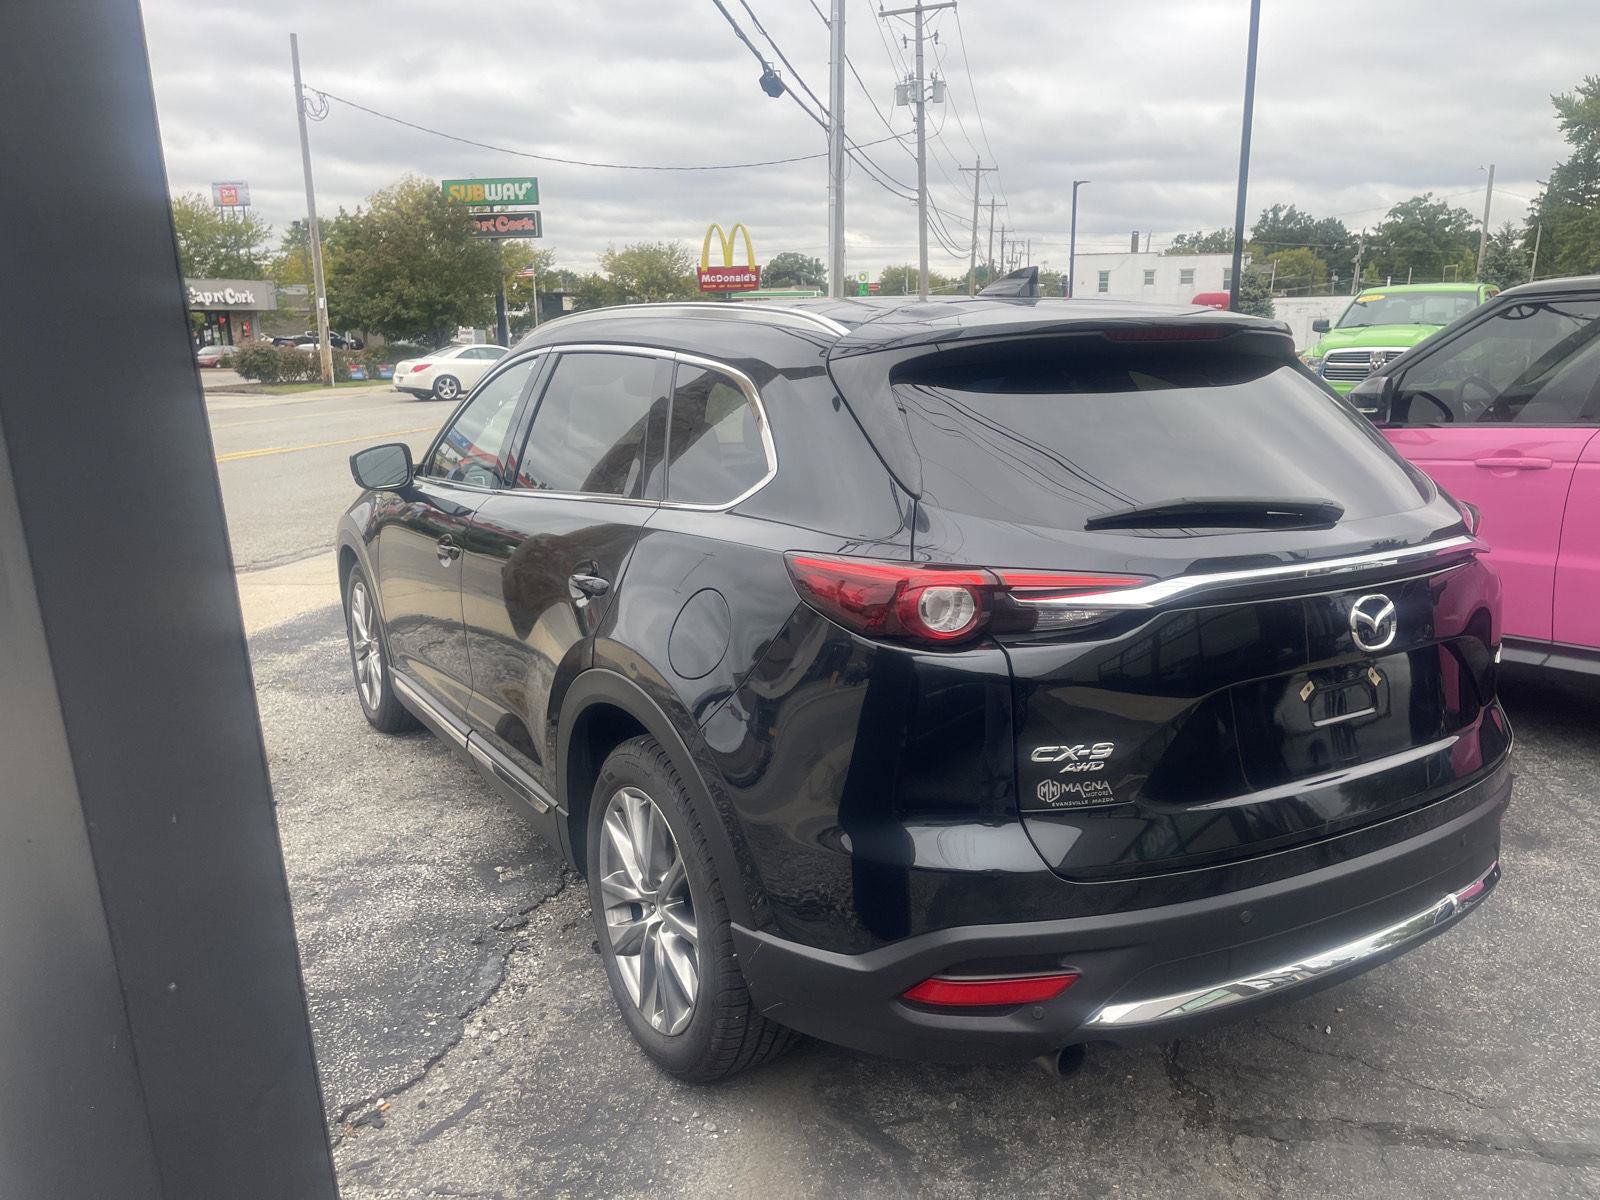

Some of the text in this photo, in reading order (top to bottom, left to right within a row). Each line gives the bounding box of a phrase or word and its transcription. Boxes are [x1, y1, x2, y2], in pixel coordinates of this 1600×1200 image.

[448, 182, 532, 201] SUBWAY
[701, 274, 757, 282] McDonald's
[224, 288, 256, 305] Cork
[1031, 742, 1115, 762] CX-9
[1060, 761, 1104, 773] AWD
[1061, 780, 1113, 798] MAGNA
